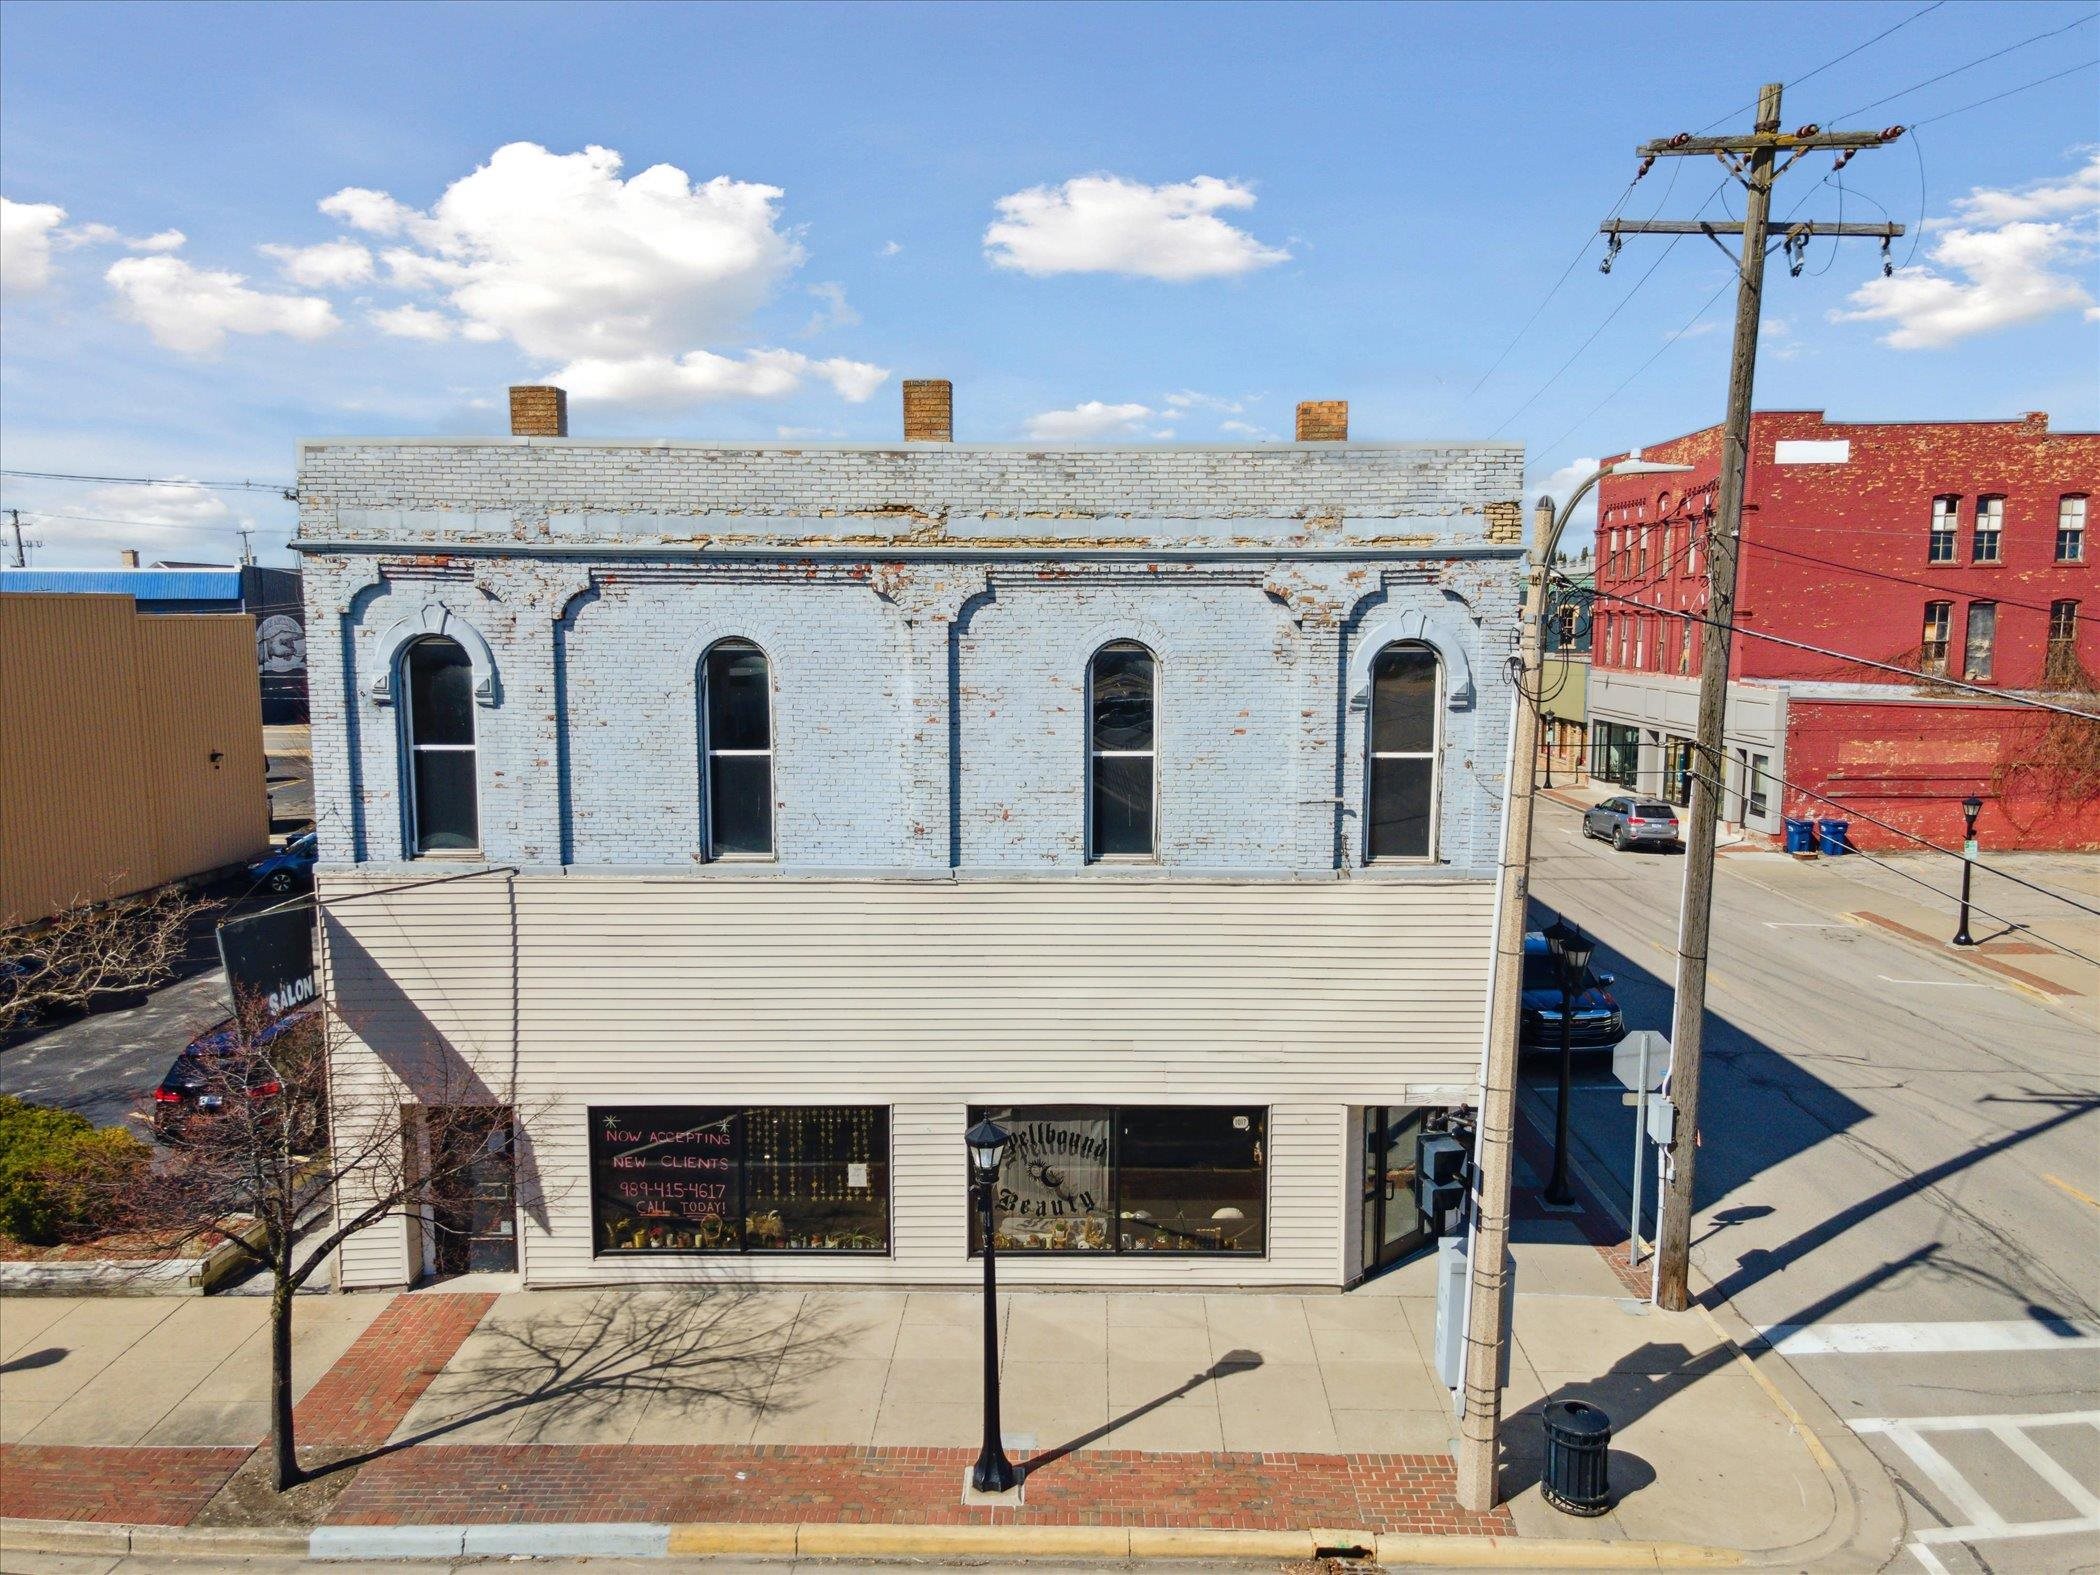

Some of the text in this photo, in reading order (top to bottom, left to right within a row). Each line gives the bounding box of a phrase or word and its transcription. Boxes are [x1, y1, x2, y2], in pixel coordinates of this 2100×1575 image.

[269, 974, 314, 1016] SALON
[606, 1130, 731, 1145] NOW ACCEPTING
[1005, 1122, 1108, 1158] pellbound
[613, 1155, 729, 1170] NEW CLIENTS
[620, 1181, 726, 1199] 989-415-4617
[635, 1201, 726, 1215] CALL TODAY!
[995, 1188, 1095, 1217] Beauty
